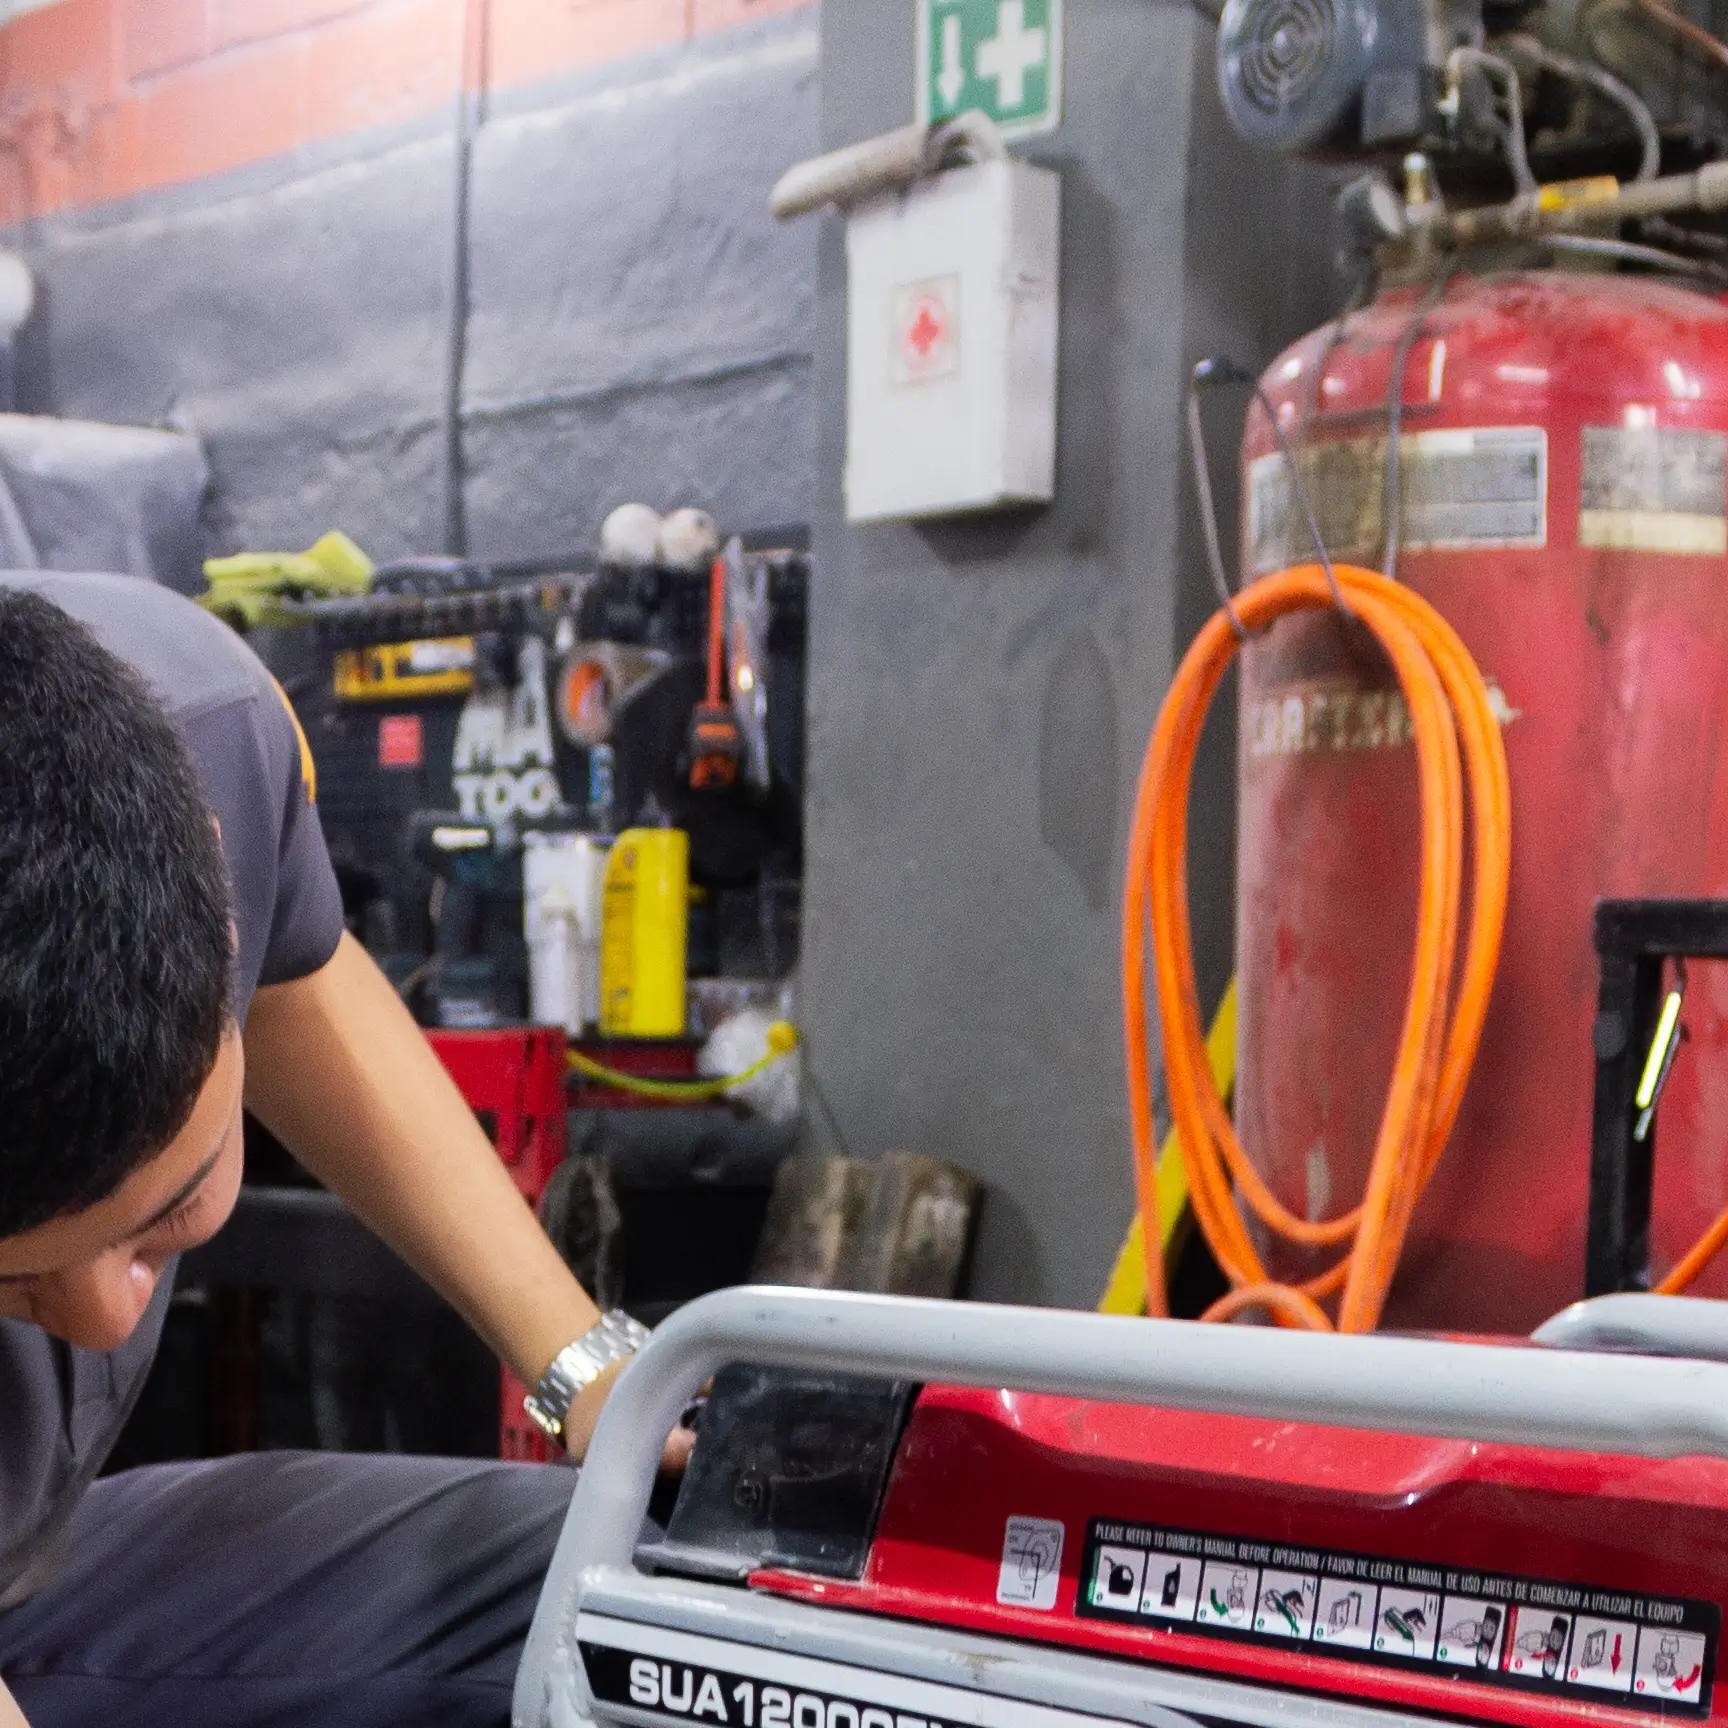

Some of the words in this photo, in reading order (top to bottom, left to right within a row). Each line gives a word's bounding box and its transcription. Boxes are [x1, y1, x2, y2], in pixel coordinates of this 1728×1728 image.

[1203, 1537, 1236, 1559] MANUAL
[1272, 1547, 1320, 1571] OPERATION
[1327, 1554, 1355, 1576] FAVOR
[1407, 1567, 1443, 1589] MANUAL
[1461, 1573, 1480, 1593] USO
[1482, 1577, 1512, 1598] ANTES
[1515, 1582, 1528, 1601] DE
[1530, 1584, 1582, 1607] COMENZAR
[1591, 1593, 1633, 1615] UTILIZAR
[1633, 1598, 1645, 1618] EL
[1648, 1600, 1684, 1624] EQUIPO
